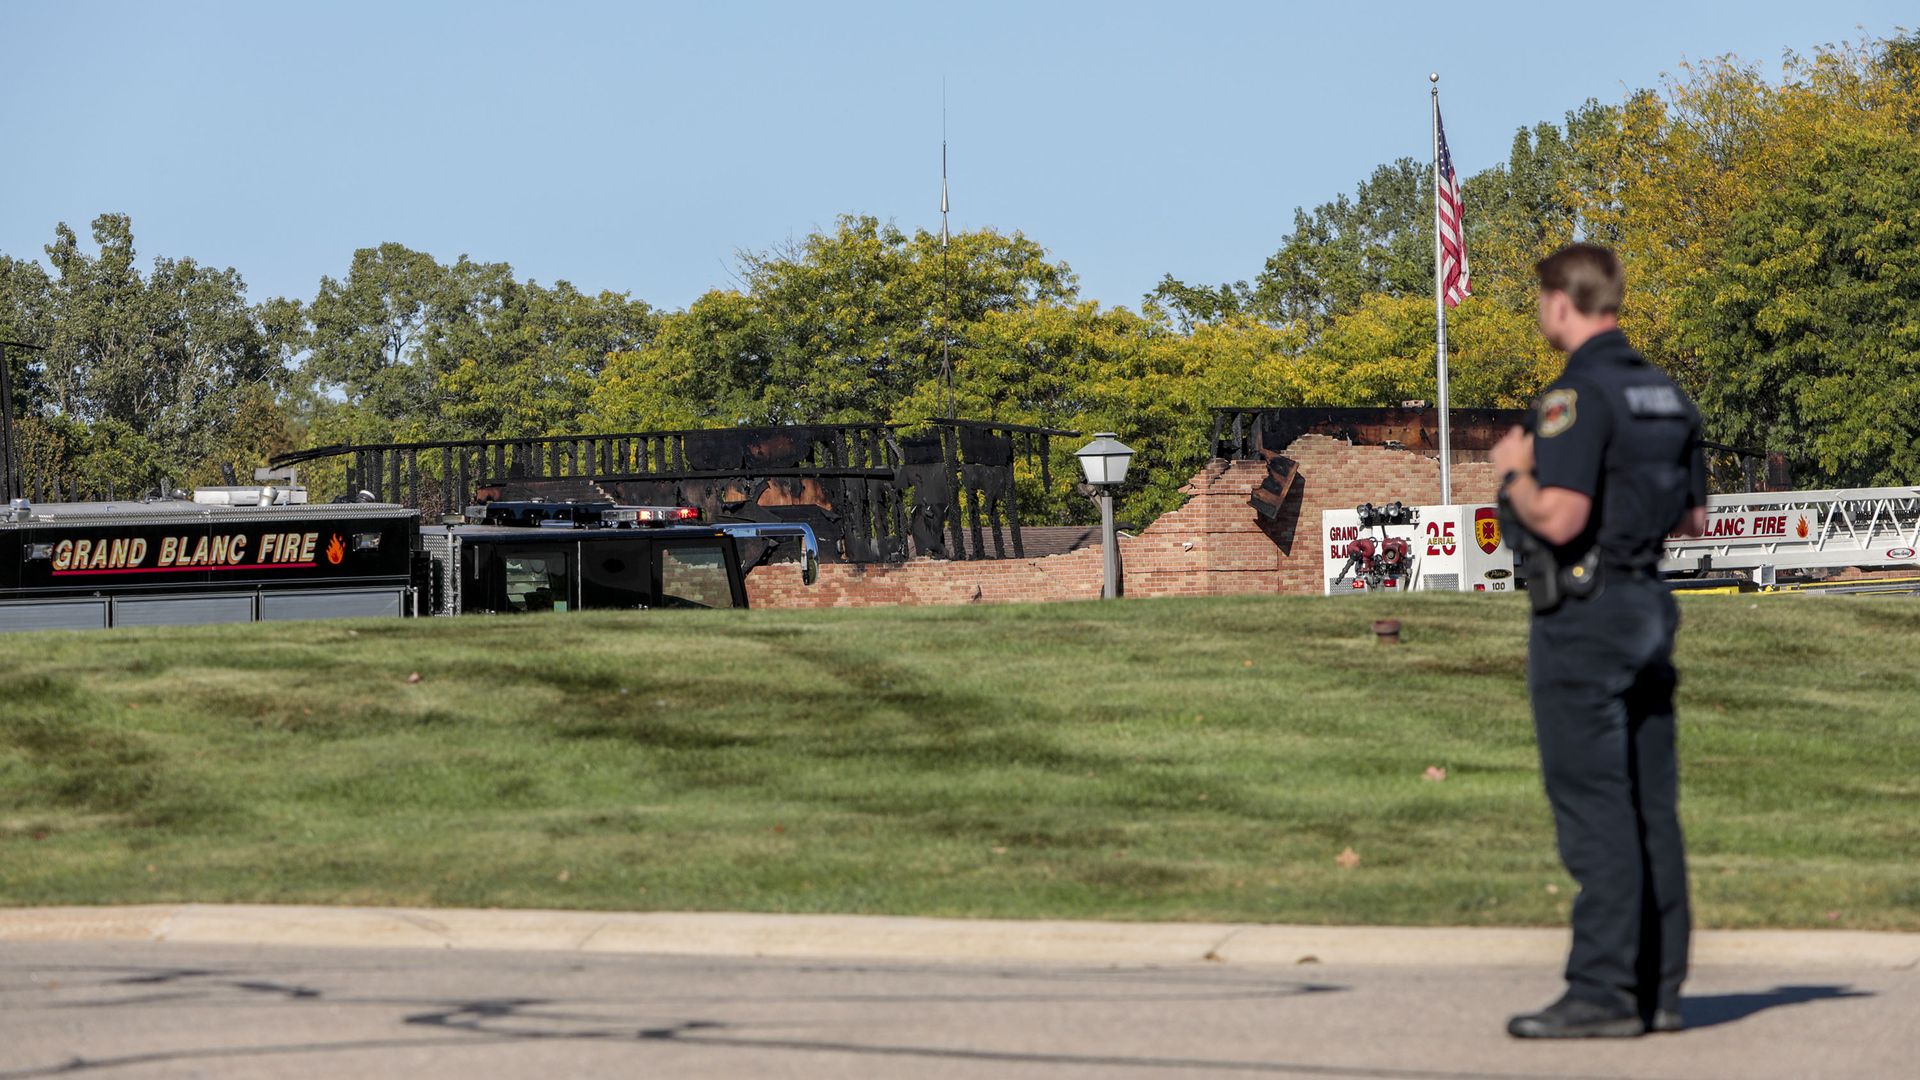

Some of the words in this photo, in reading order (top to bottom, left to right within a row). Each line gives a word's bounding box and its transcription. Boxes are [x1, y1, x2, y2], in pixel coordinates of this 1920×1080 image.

[1330, 526, 1358, 541] GRAND
[1704, 517, 1745, 536] LANC
[1753, 515, 1787, 535] FIRE
[1426, 521, 1456, 556] 25
[1427, 537, 1455, 545] AERIAL
[52, 539, 148, 570] GRAND
[158, 534, 247, 566] BLANC
[257, 532, 319, 563] FIRE
[1492, 582, 1505, 590] 100
